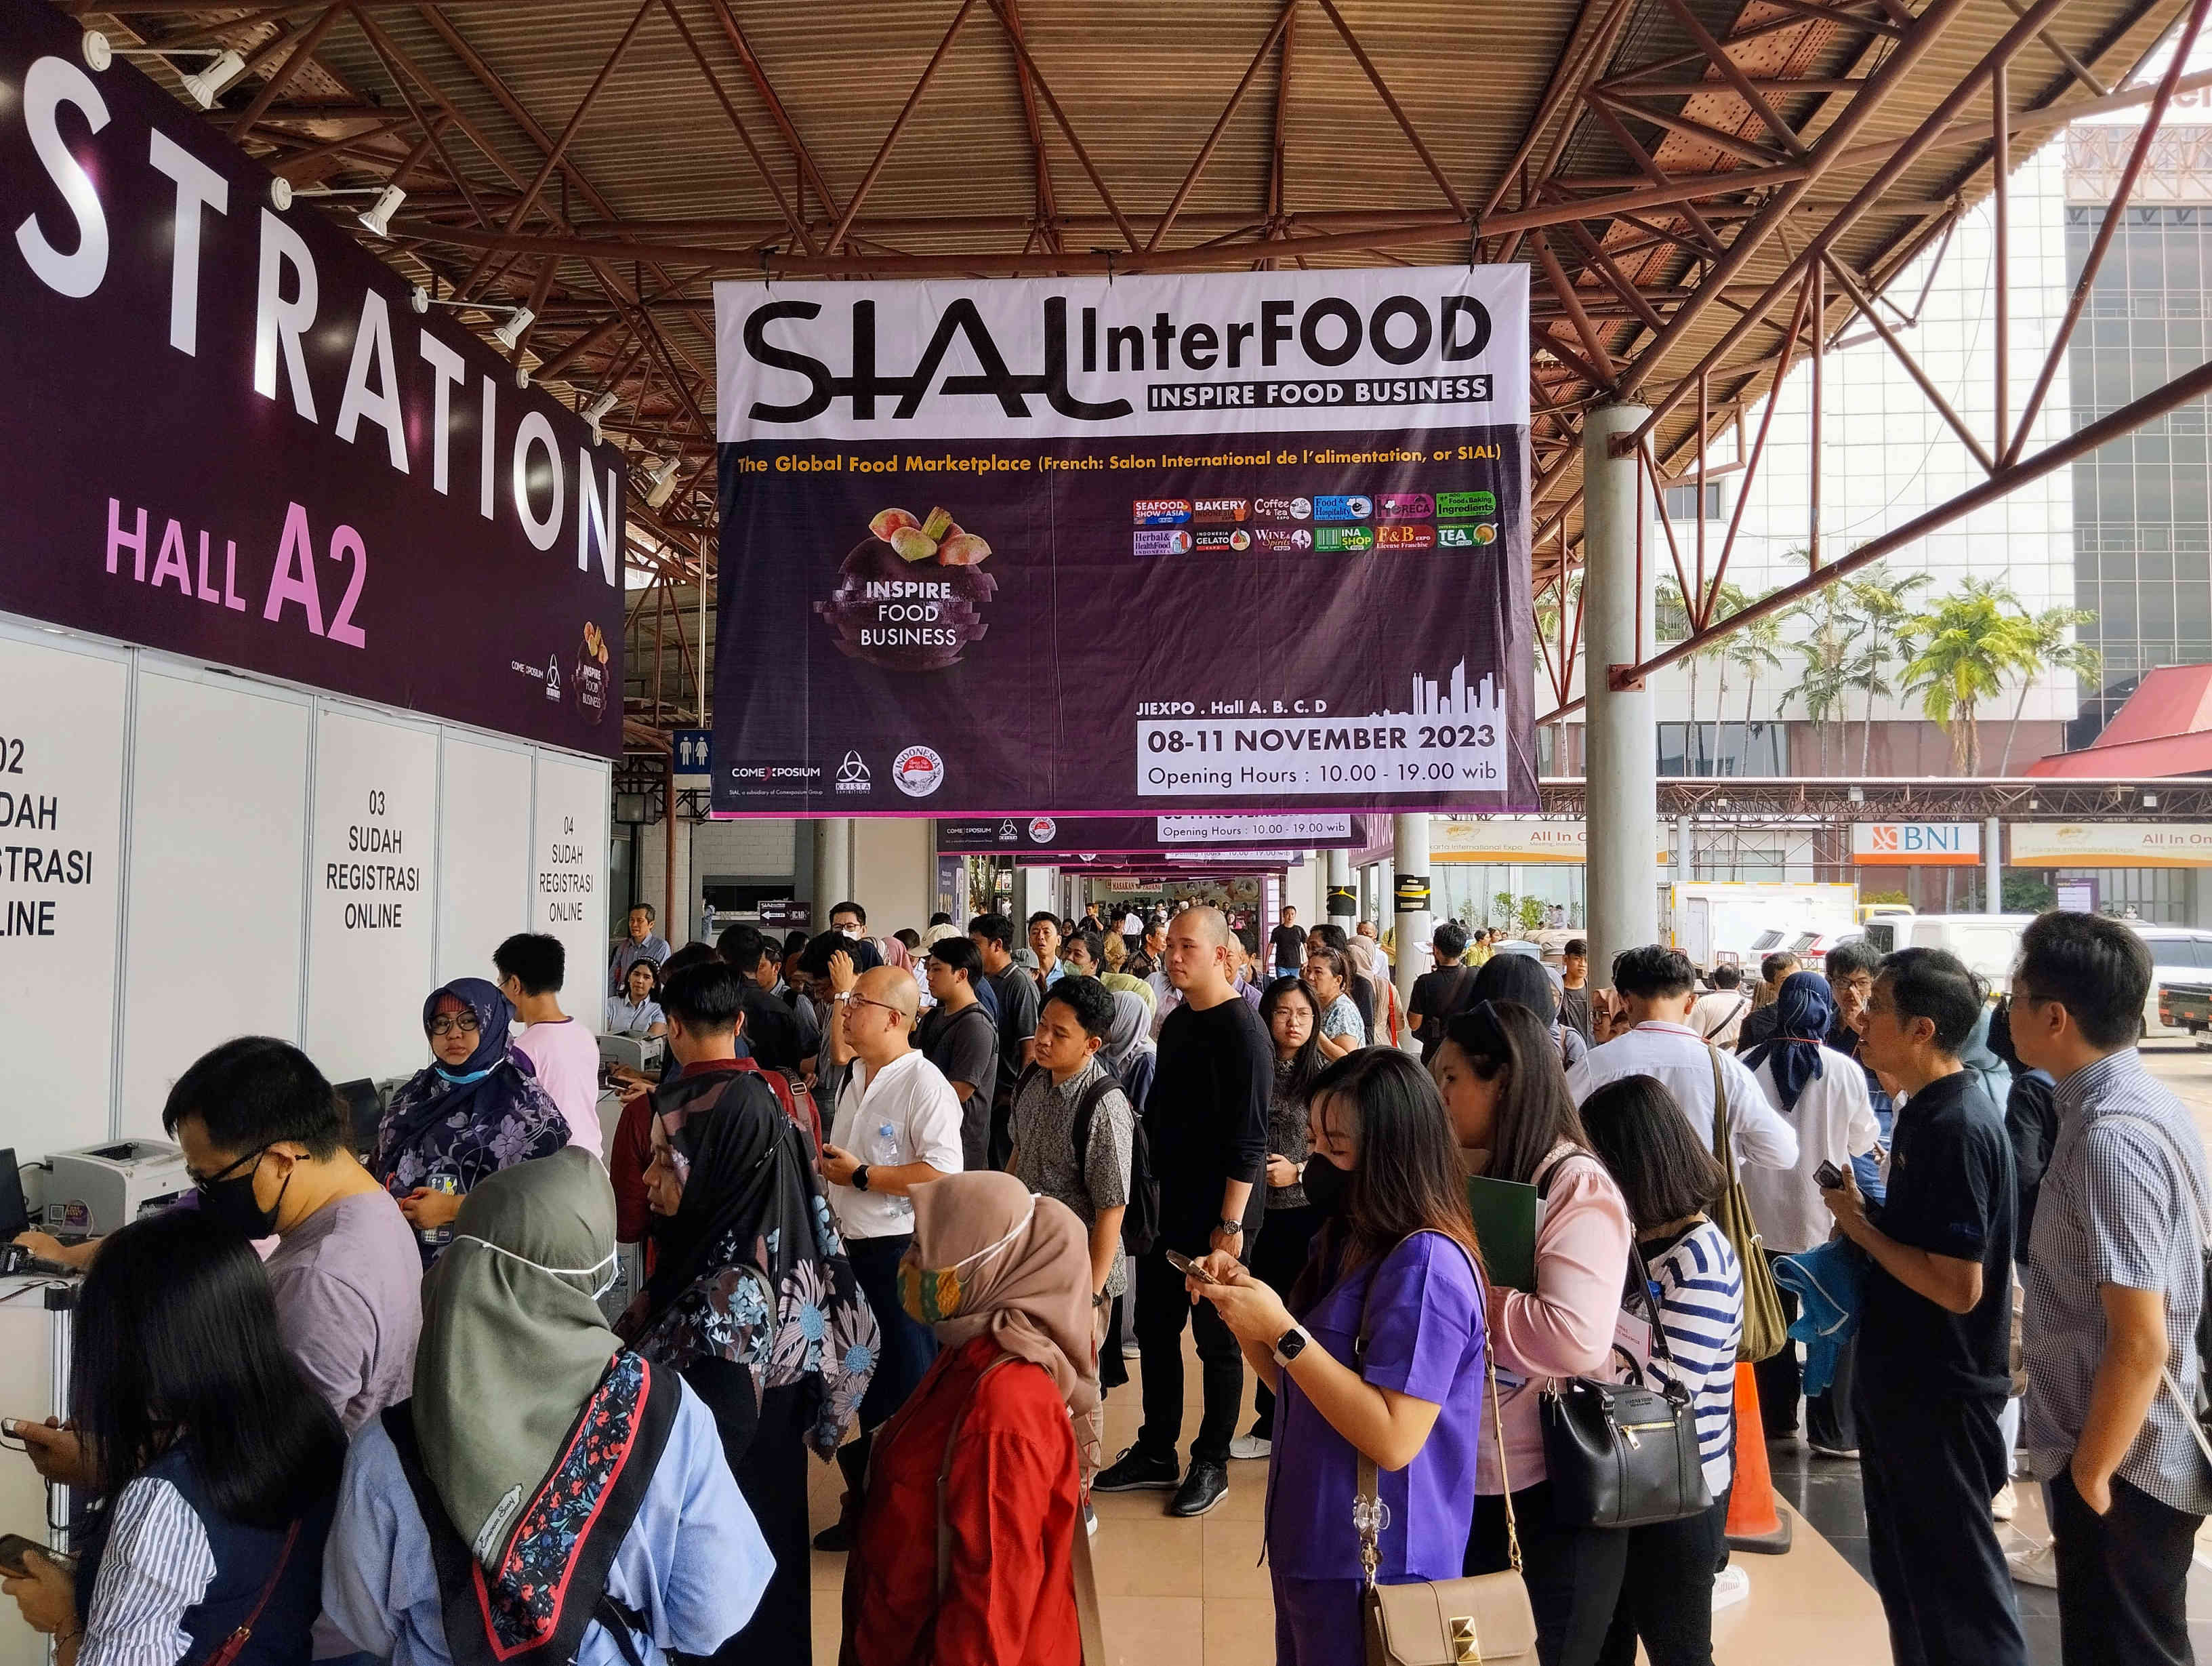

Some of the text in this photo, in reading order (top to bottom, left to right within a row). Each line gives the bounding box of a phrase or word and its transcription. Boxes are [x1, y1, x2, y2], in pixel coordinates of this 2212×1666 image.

[15, 56, 616, 588] STRATION
[1082, 296, 1492, 372] InterFOOD
[743, 296, 1134, 423] SIAL
[1152, 378, 1487, 407] INSPIRE FOOD BUSINESS
[738, 455, 768, 473] The
[775, 455, 842, 472] Global
[850, 455, 898, 472] Food
[905, 454, 1031, 475] Marketplace
[1038, 455, 1103, 473] (French:
[1109, 454, 1156, 469] Salon
[1162, 451, 1270, 468] International
[1277, 450, 1298, 465] de
[1433, 451, 1452, 461] or
[1458, 443, 1501, 461] SIAL)
[1136, 502, 1184, 510] SEAFOOD
[1195, 500, 1247, 510] BAKERY
[1254, 498, 1290, 514] Coffee
[1316, 498, 1336, 506] Food
[1438, 504, 1494, 515] Ingredients
[1136, 533, 1163, 541] Herbal
[1255, 529, 1286, 540] WINE
[1342, 529, 1361, 537] INA
[1342, 537, 1372, 545] SHOP
[1439, 529, 1467, 541] TEA
[106, 497, 366, 649] HALL A2
[866, 582, 951, 599] INSPIRE
[878, 605, 939, 622] FOOD
[861, 628, 956, 645] BUSINESS
[583, 664, 601, 680] INSPIRE
[586, 680, 598, 693] FOOD
[582, 693, 601, 708] BUSINESS
[1136, 702, 1195, 716] JIEXPO
[1212, 701, 1244, 714] Hall
[1249, 702, 1267, 714] A.
[1273, 701, 1288, 714] B.
[1294, 700, 1309, 713] C.
[1315, 700, 1327, 713] D
[1148, 725, 1495, 752] 08-11 NOVEMBER 2023
[895, 748, 940, 769] INDONESIA
[732, 767, 820, 781] COMEXPOSIUM
[1148, 767, 1232, 788] Opening
[1241, 766, 1297, 783] Hours
[1319, 765, 1376, 782] 10.00
[1399, 763, 1454, 780] 19.00
[1462, 761, 1497, 779] wib
[369, 790, 385, 815] 03
[564, 816, 574, 835] 04
[1163, 826, 1208, 838] Opening
[1212, 826, 1241, 835] Hours
[1254, 825, 1282, 834] 10.00
[1294, 823, 1323, 832] 19.00
[1327, 822, 1345, 832] wib
[348, 826, 402, 853] SUDAH
[1530, 831, 1551, 841] All
[1557, 831, 1571, 841] In
[1904, 826, 1961, 851] BNI
[2142, 833, 2163, 845] All
[2169, 833, 2184, 845] In
[552, 845, 583, 864] SUDAH
[0, 847, 92, 885] TRASI
[327, 863, 419, 891] REGISTRASI
[539, 873, 593, 893] REGISTRASI
[345, 903, 402, 929] ONLINE
[549, 902, 582, 922] ONLINE
